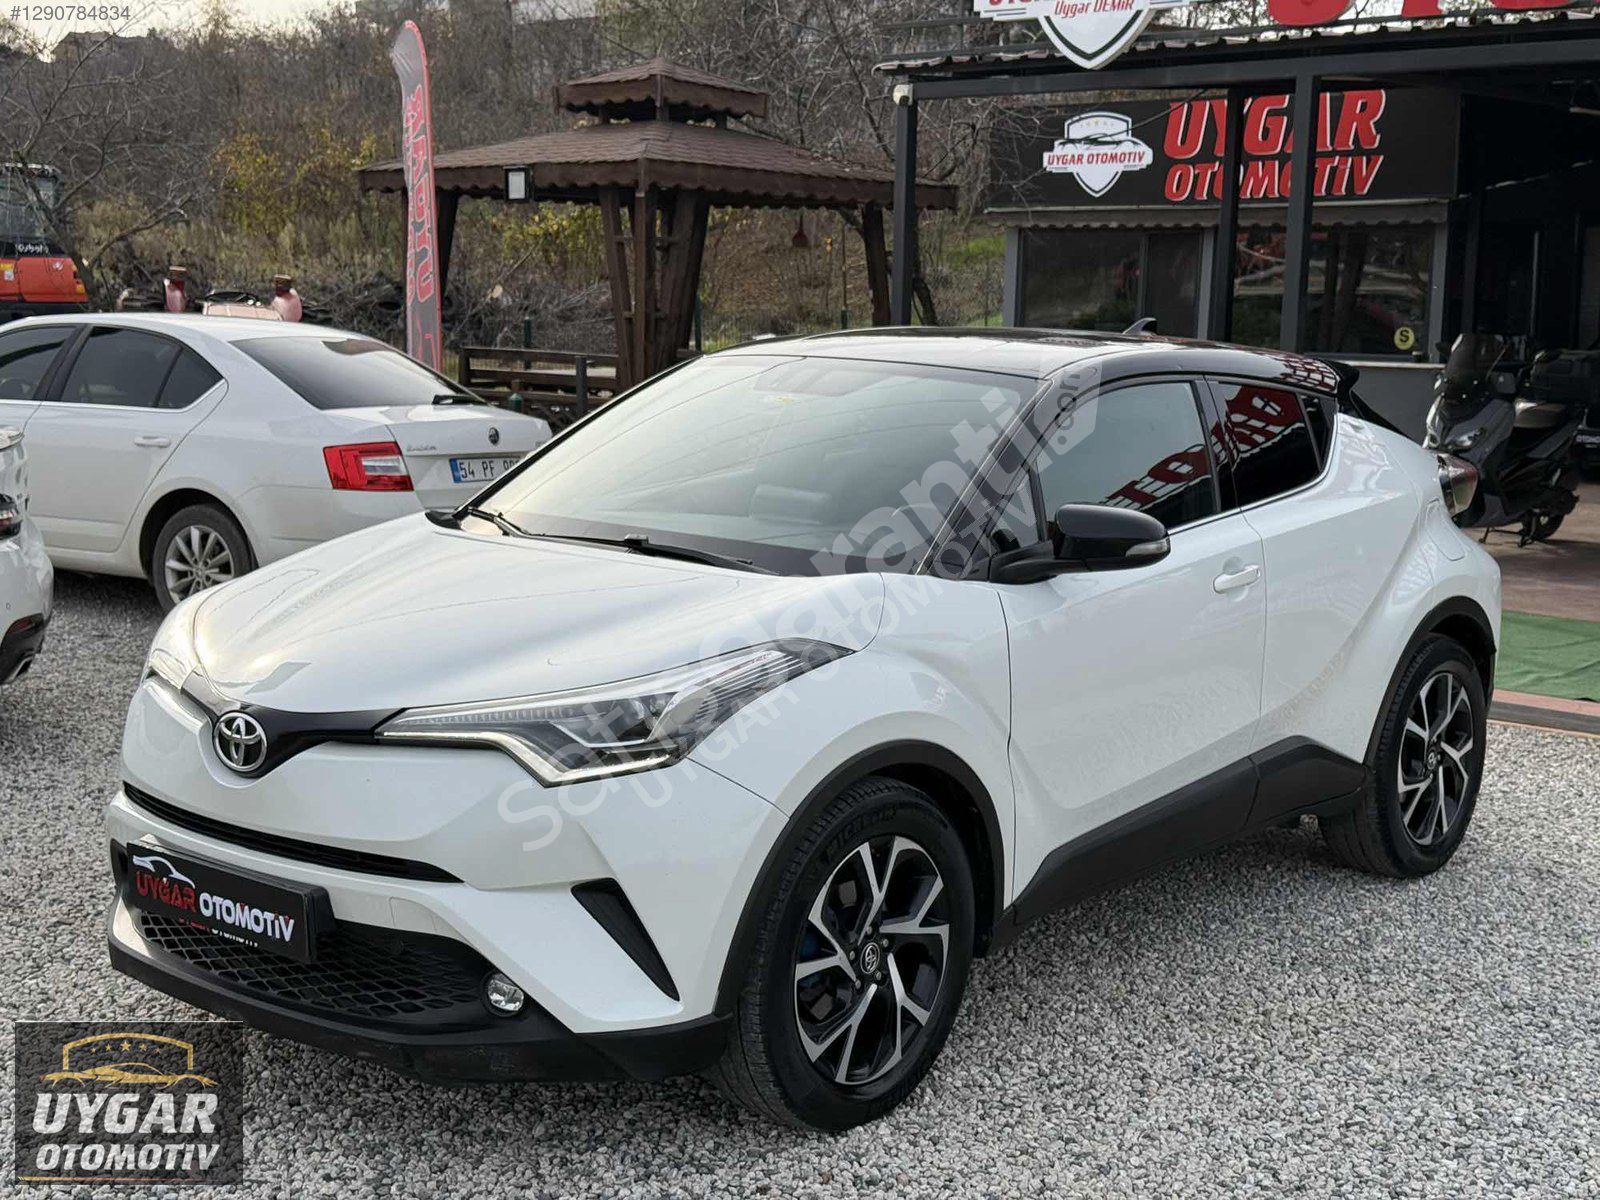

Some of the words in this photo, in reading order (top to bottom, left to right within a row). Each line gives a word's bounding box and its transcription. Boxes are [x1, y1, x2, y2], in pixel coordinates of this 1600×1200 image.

[1055, 1, 1091, 18] Uygar
[1048, 153, 1084, 166] UYGAR
[1399, 329, 1410, 343] S
[459, 461, 475, 479] 54
[481, 460, 495, 477] PF
[136, 871, 197, 912] UYGAR
